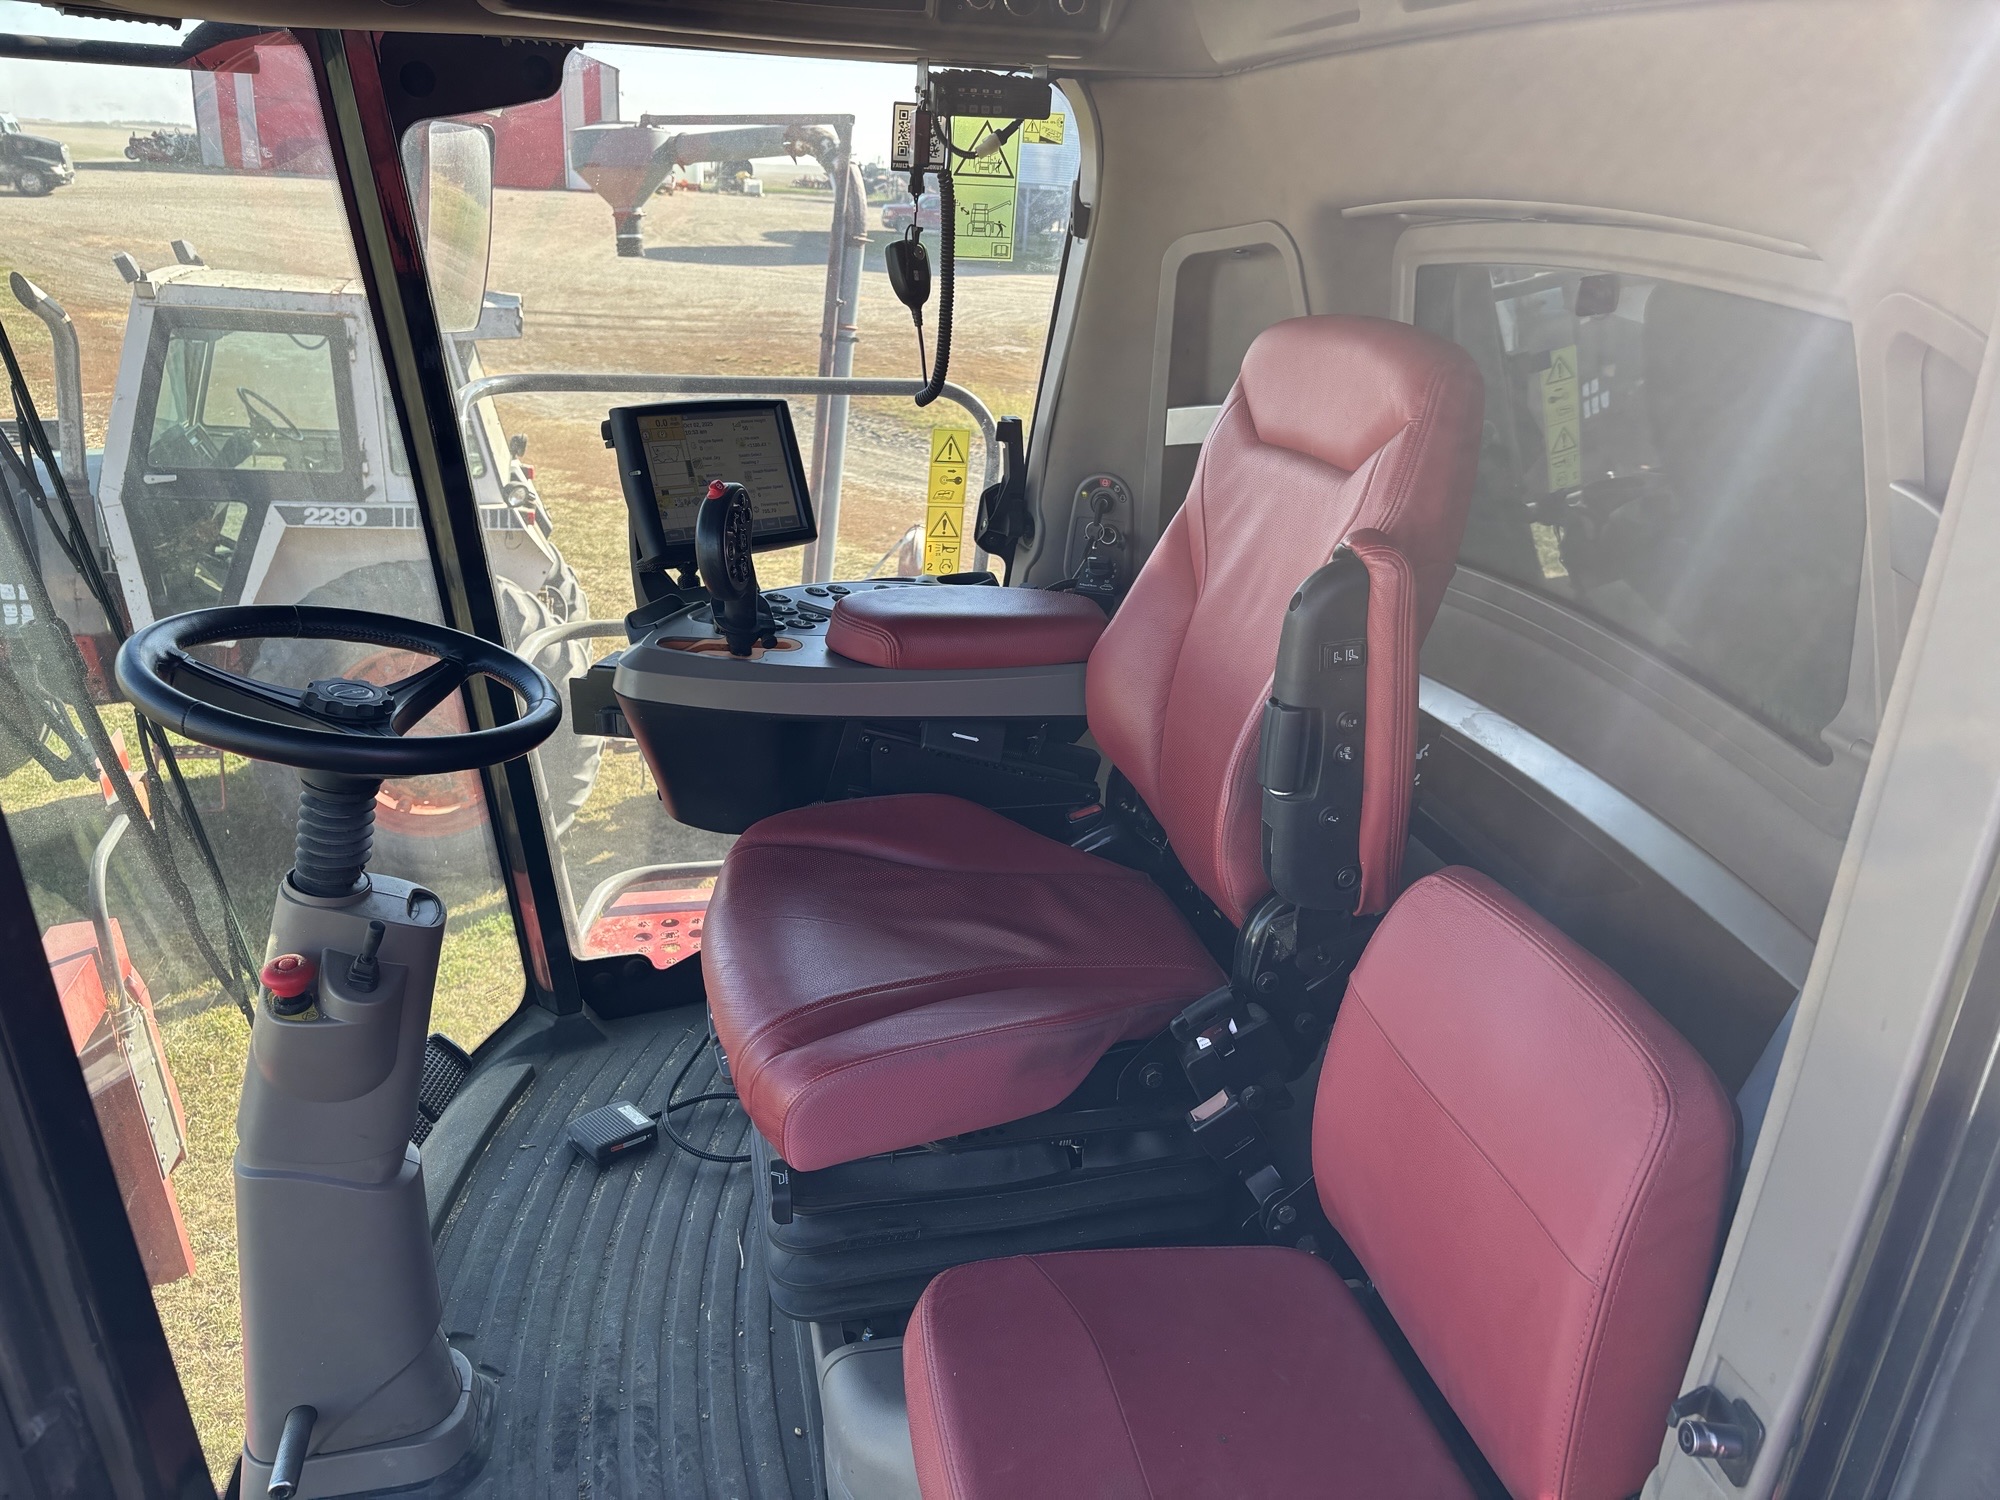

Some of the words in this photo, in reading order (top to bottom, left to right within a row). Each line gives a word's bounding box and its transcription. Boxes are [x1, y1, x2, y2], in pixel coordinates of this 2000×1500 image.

[655, 419, 668, 428] 0.0
[303, 507, 368, 526] 2290
[928, 544, 932, 552] 1
[926, 562, 933, 571] 2
